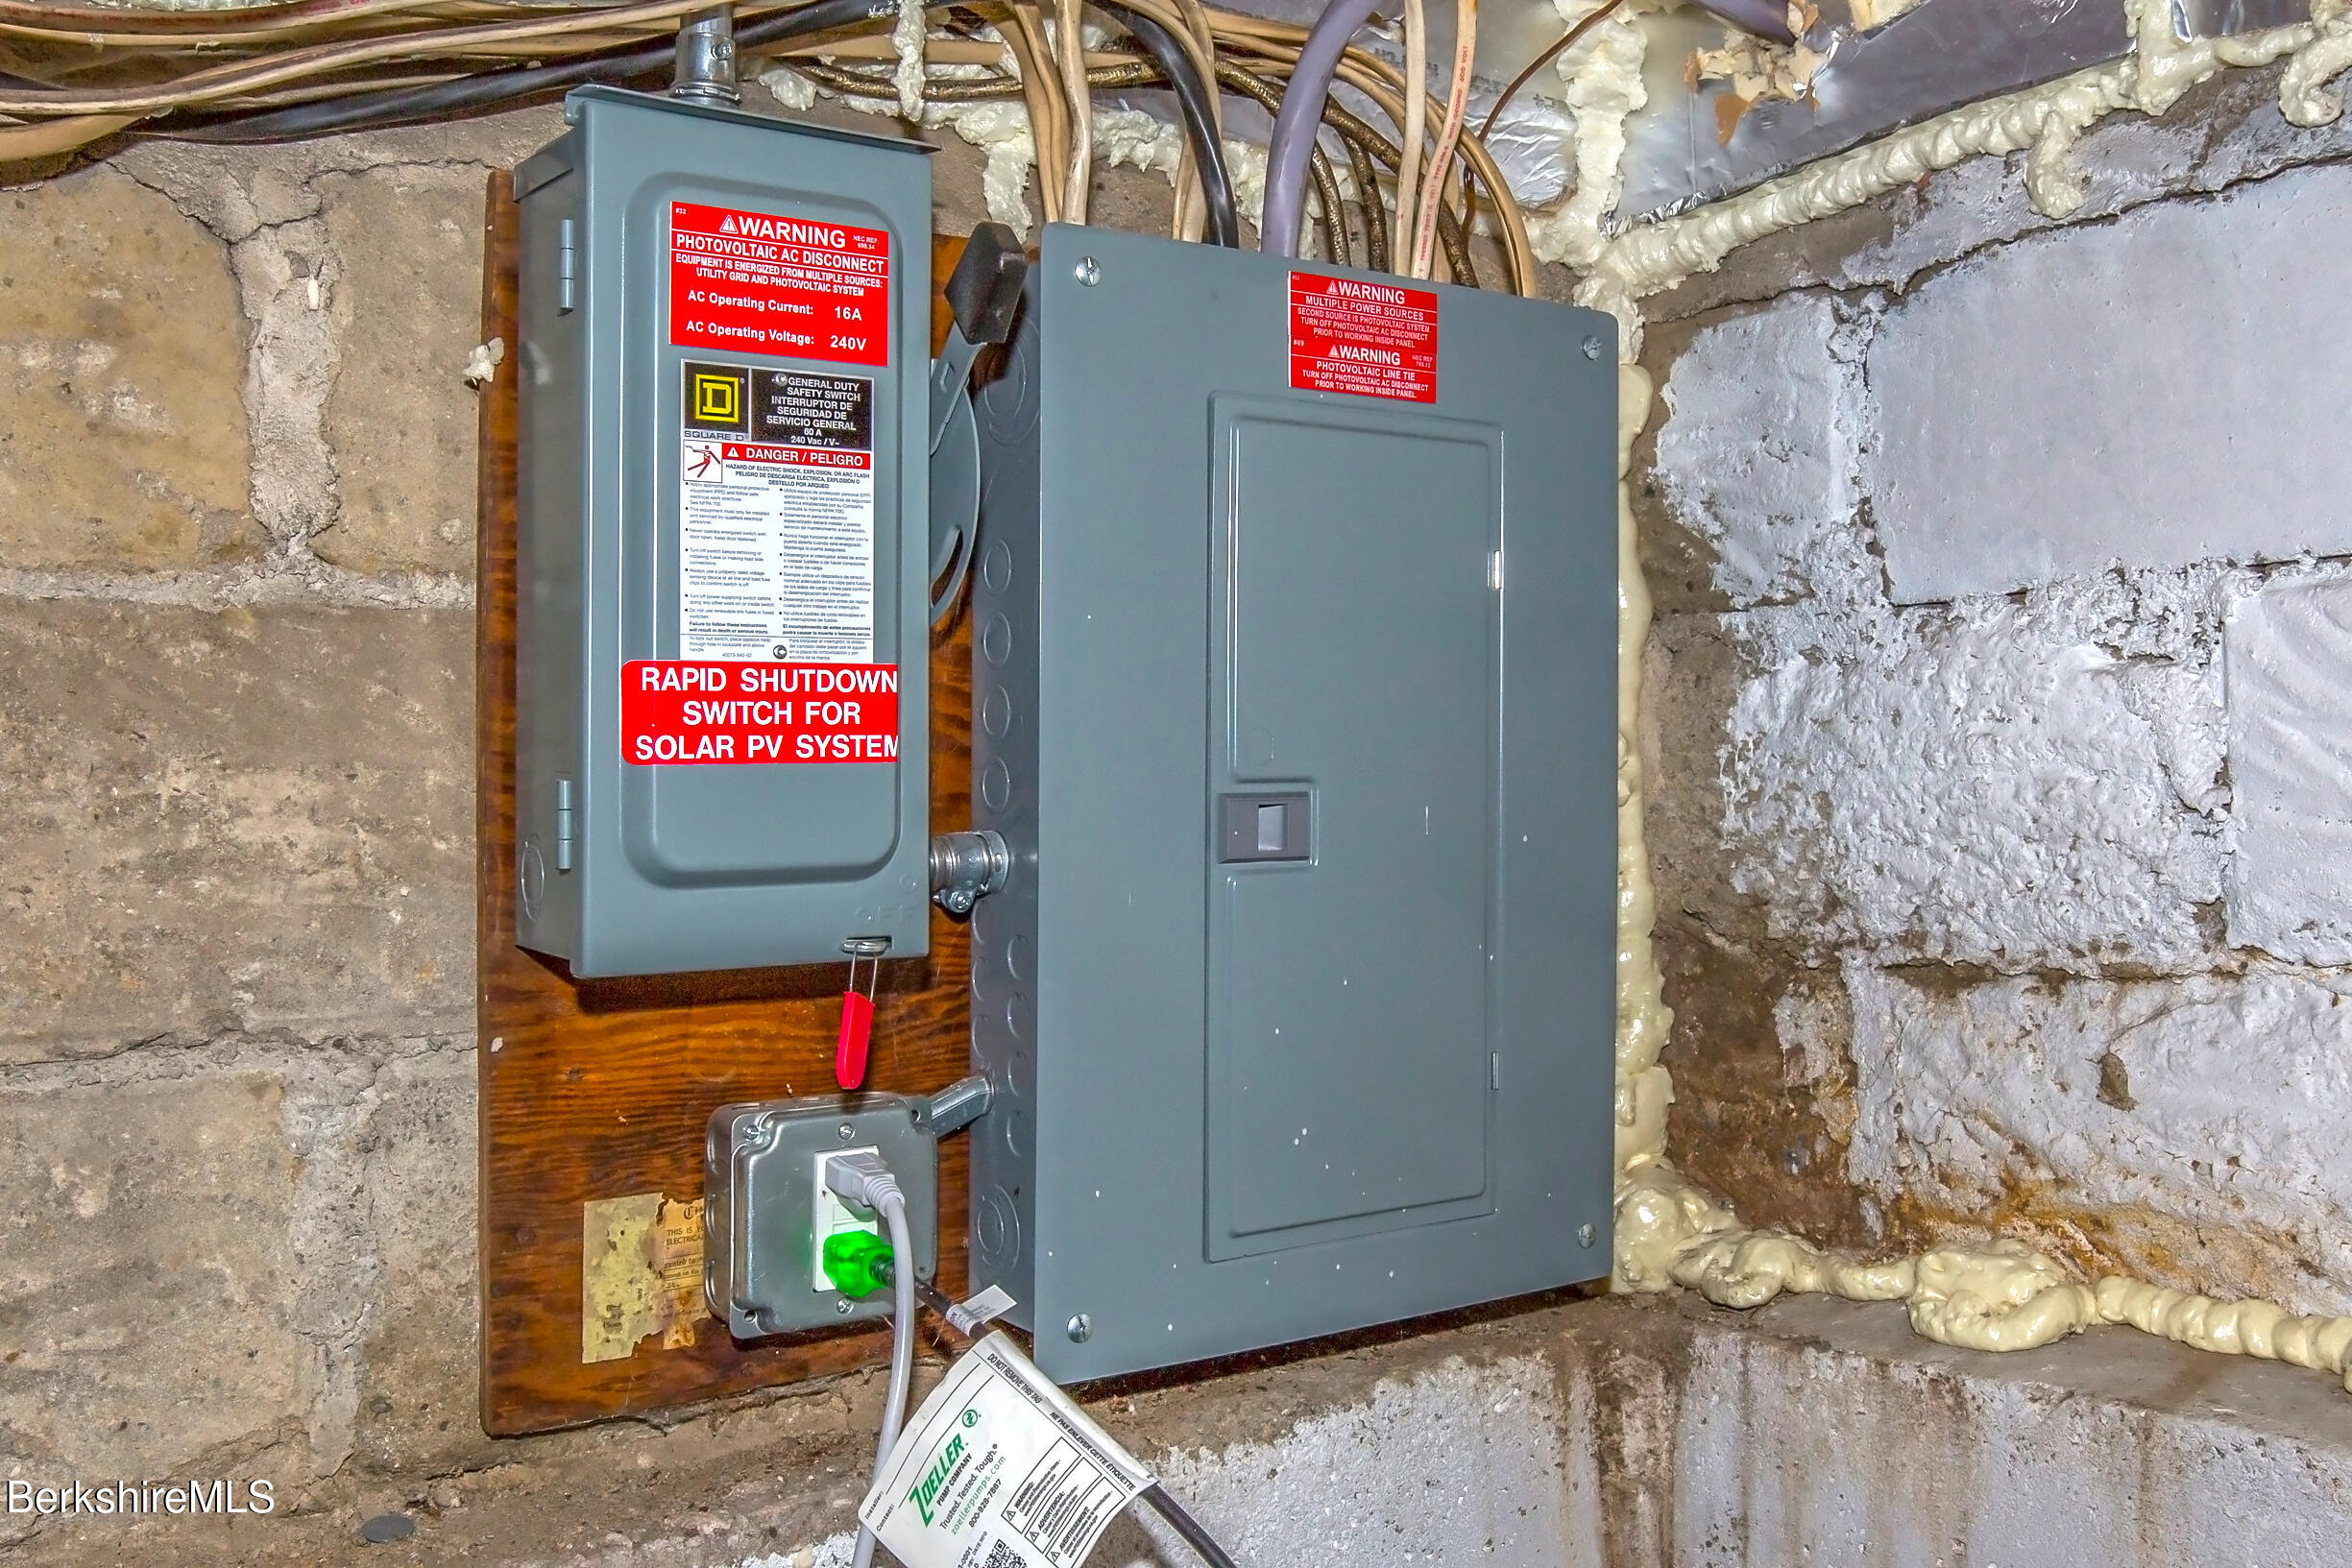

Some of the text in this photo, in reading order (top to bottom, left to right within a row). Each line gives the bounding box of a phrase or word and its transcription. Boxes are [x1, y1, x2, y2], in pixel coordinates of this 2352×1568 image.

[739, 216, 845, 249] WARNING
[676, 234, 884, 274] PHOTOVOLTAIC AC DISCONNECT
[675, 253, 883, 288] EQUIPMENT IS ENERGIZED FROM MULTIPLE SOURCES:
[696, 267, 864, 297] UTILITY GRID AND PHOTOVOLTAIC SYSTEM
[1338, 281, 1405, 304] WARNING
[688, 290, 862, 322] AC Operating Current: 16A
[1297, 307, 1324, 318] SECOND
[1325, 311, 1351, 322] SOURCE
[1360, 316, 1405, 329] PHOTOVOLTAIC
[1306, 296, 1424, 321] MULTIPLE POWER SOURCES
[686, 320, 867, 351] AC Operating Voltage: 240V
[1300, 316, 1319, 326] TURN
[1333, 321, 1380, 334] PHOTOVOLTAIC
[1380, 327, 1390, 336] AC
[1391, 329, 1428, 341] DISCONNECT
[1313, 327, 1333, 337] PRIOR
[1345, 332, 1374, 343] WORKING
[1375, 336, 1394, 345] INSIDE
[1339, 345, 1401, 366] WARNING
[1302, 369, 1320, 378] TURN
[1321, 372, 1333, 380] OFF
[1334, 374, 1380, 386] PHOTOVOLTAIC
[1392, 380, 1428, 392] DISCONNECT
[1316, 360, 1416, 381] PHOTOVOLTAIC LINE TIE
[787, 387, 861, 401] SAFETY SWITCH
[788, 377, 860, 392] GENERAL DUTY
[1315, 379, 1335, 389] PRIOR
[1346, 383, 1374, 394] WORKING
[1375, 387, 1395, 396] INSIDE
[771, 396, 853, 411] INTERRUPTOR DE
[777, 406, 847, 421] SEGURIDAD DE
[685, 430, 731, 440] SQUARE
[766, 415, 857, 431] SERVICIO GENERAL
[790, 435, 806, 444] 240
[807, 437, 822, 446] Vac
[745, 448, 863, 467] DANGER / PELIGRO
[642, 666, 898, 693] RAPID SHUTDOWN
[682, 701, 861, 726] SWITCH FOR
[636, 735, 898, 760] SOLAR PV SYSTEM
[667, 1228, 683, 1237] THIS
[667, 1234, 704, 1245] ELECTRICA
[987, 1353, 1043, 1404] DO NOT REMOVE THIS TAG
[1050, 1411, 1060, 1421] NE
[1056, 1418, 1070, 1430] PAS
[1067, 1426, 1094, 1451] ENLEVER
[1090, 1447, 1108, 1464] CETTE
[908, 1433, 965, 1528] ZOELLER
[936, 1453, 973, 1507] PUMP COMPANY
[864, 1490, 885, 1520] Installer:
[939, 1498, 962, 1530] Trusted.
[957, 1473, 979, 1501] Tested.
[951, 1455, 1006, 1535] zoellerpumps.com
[968, 1478, 1003, 1529] 800-928-7867
[1013, 1482, 1035, 1508] WARNING:
[876, 1504, 895, 1532] Contact:
[1037, 1491, 1066, 1531] ADVERTENCIA:
[1059, 1506, 1090, 1551] AVERTISSEMENT:
[972, 1542, 982, 1556] DATE
